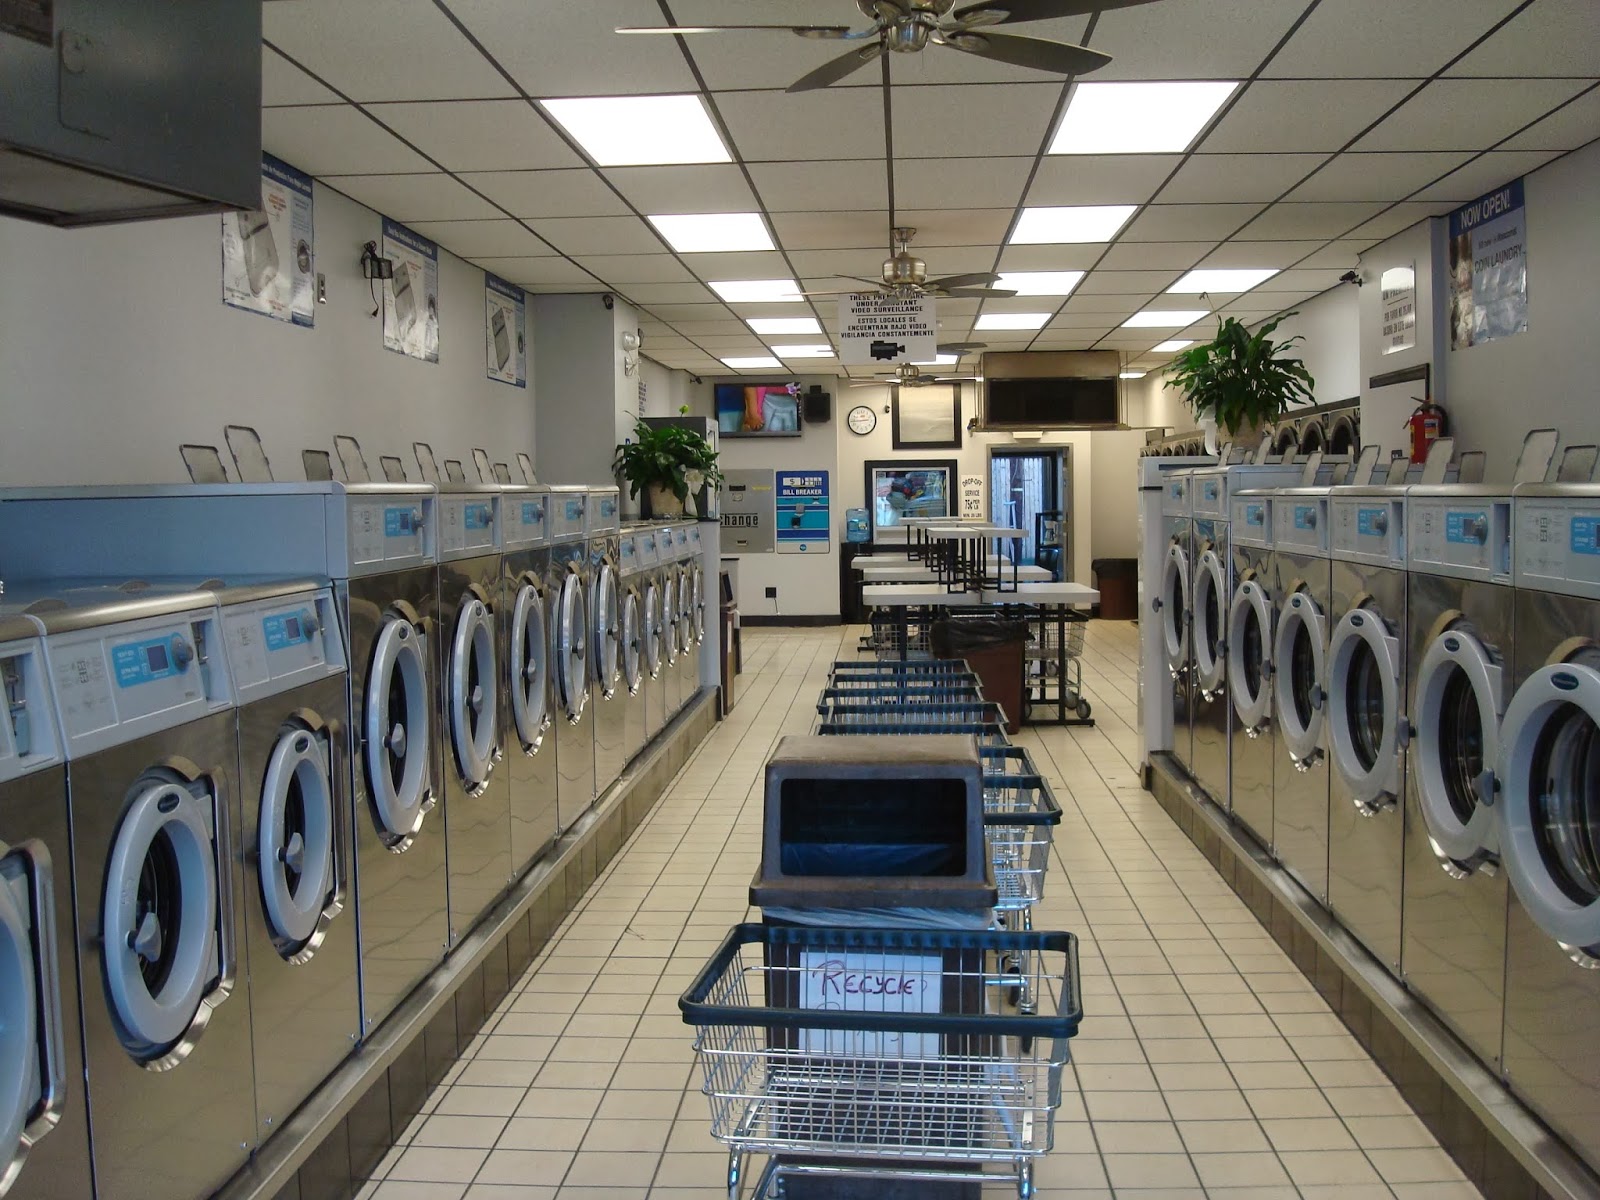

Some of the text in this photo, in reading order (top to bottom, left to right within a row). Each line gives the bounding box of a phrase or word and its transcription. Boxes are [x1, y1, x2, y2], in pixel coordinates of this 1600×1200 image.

[1461, 189, 1510, 230] NOW OPEN!
[1491, 242, 1523, 268] LAUNDRY
[873, 305, 924, 313] SURVEILLANCE
[879, 316, 906, 324] LOCALES
[840, 330, 935, 339] VIGILANCIA CONSTANTEMENTE
[962, 478, 982, 487] DROP-OFF
[796, 488, 823, 496] BREAKER
